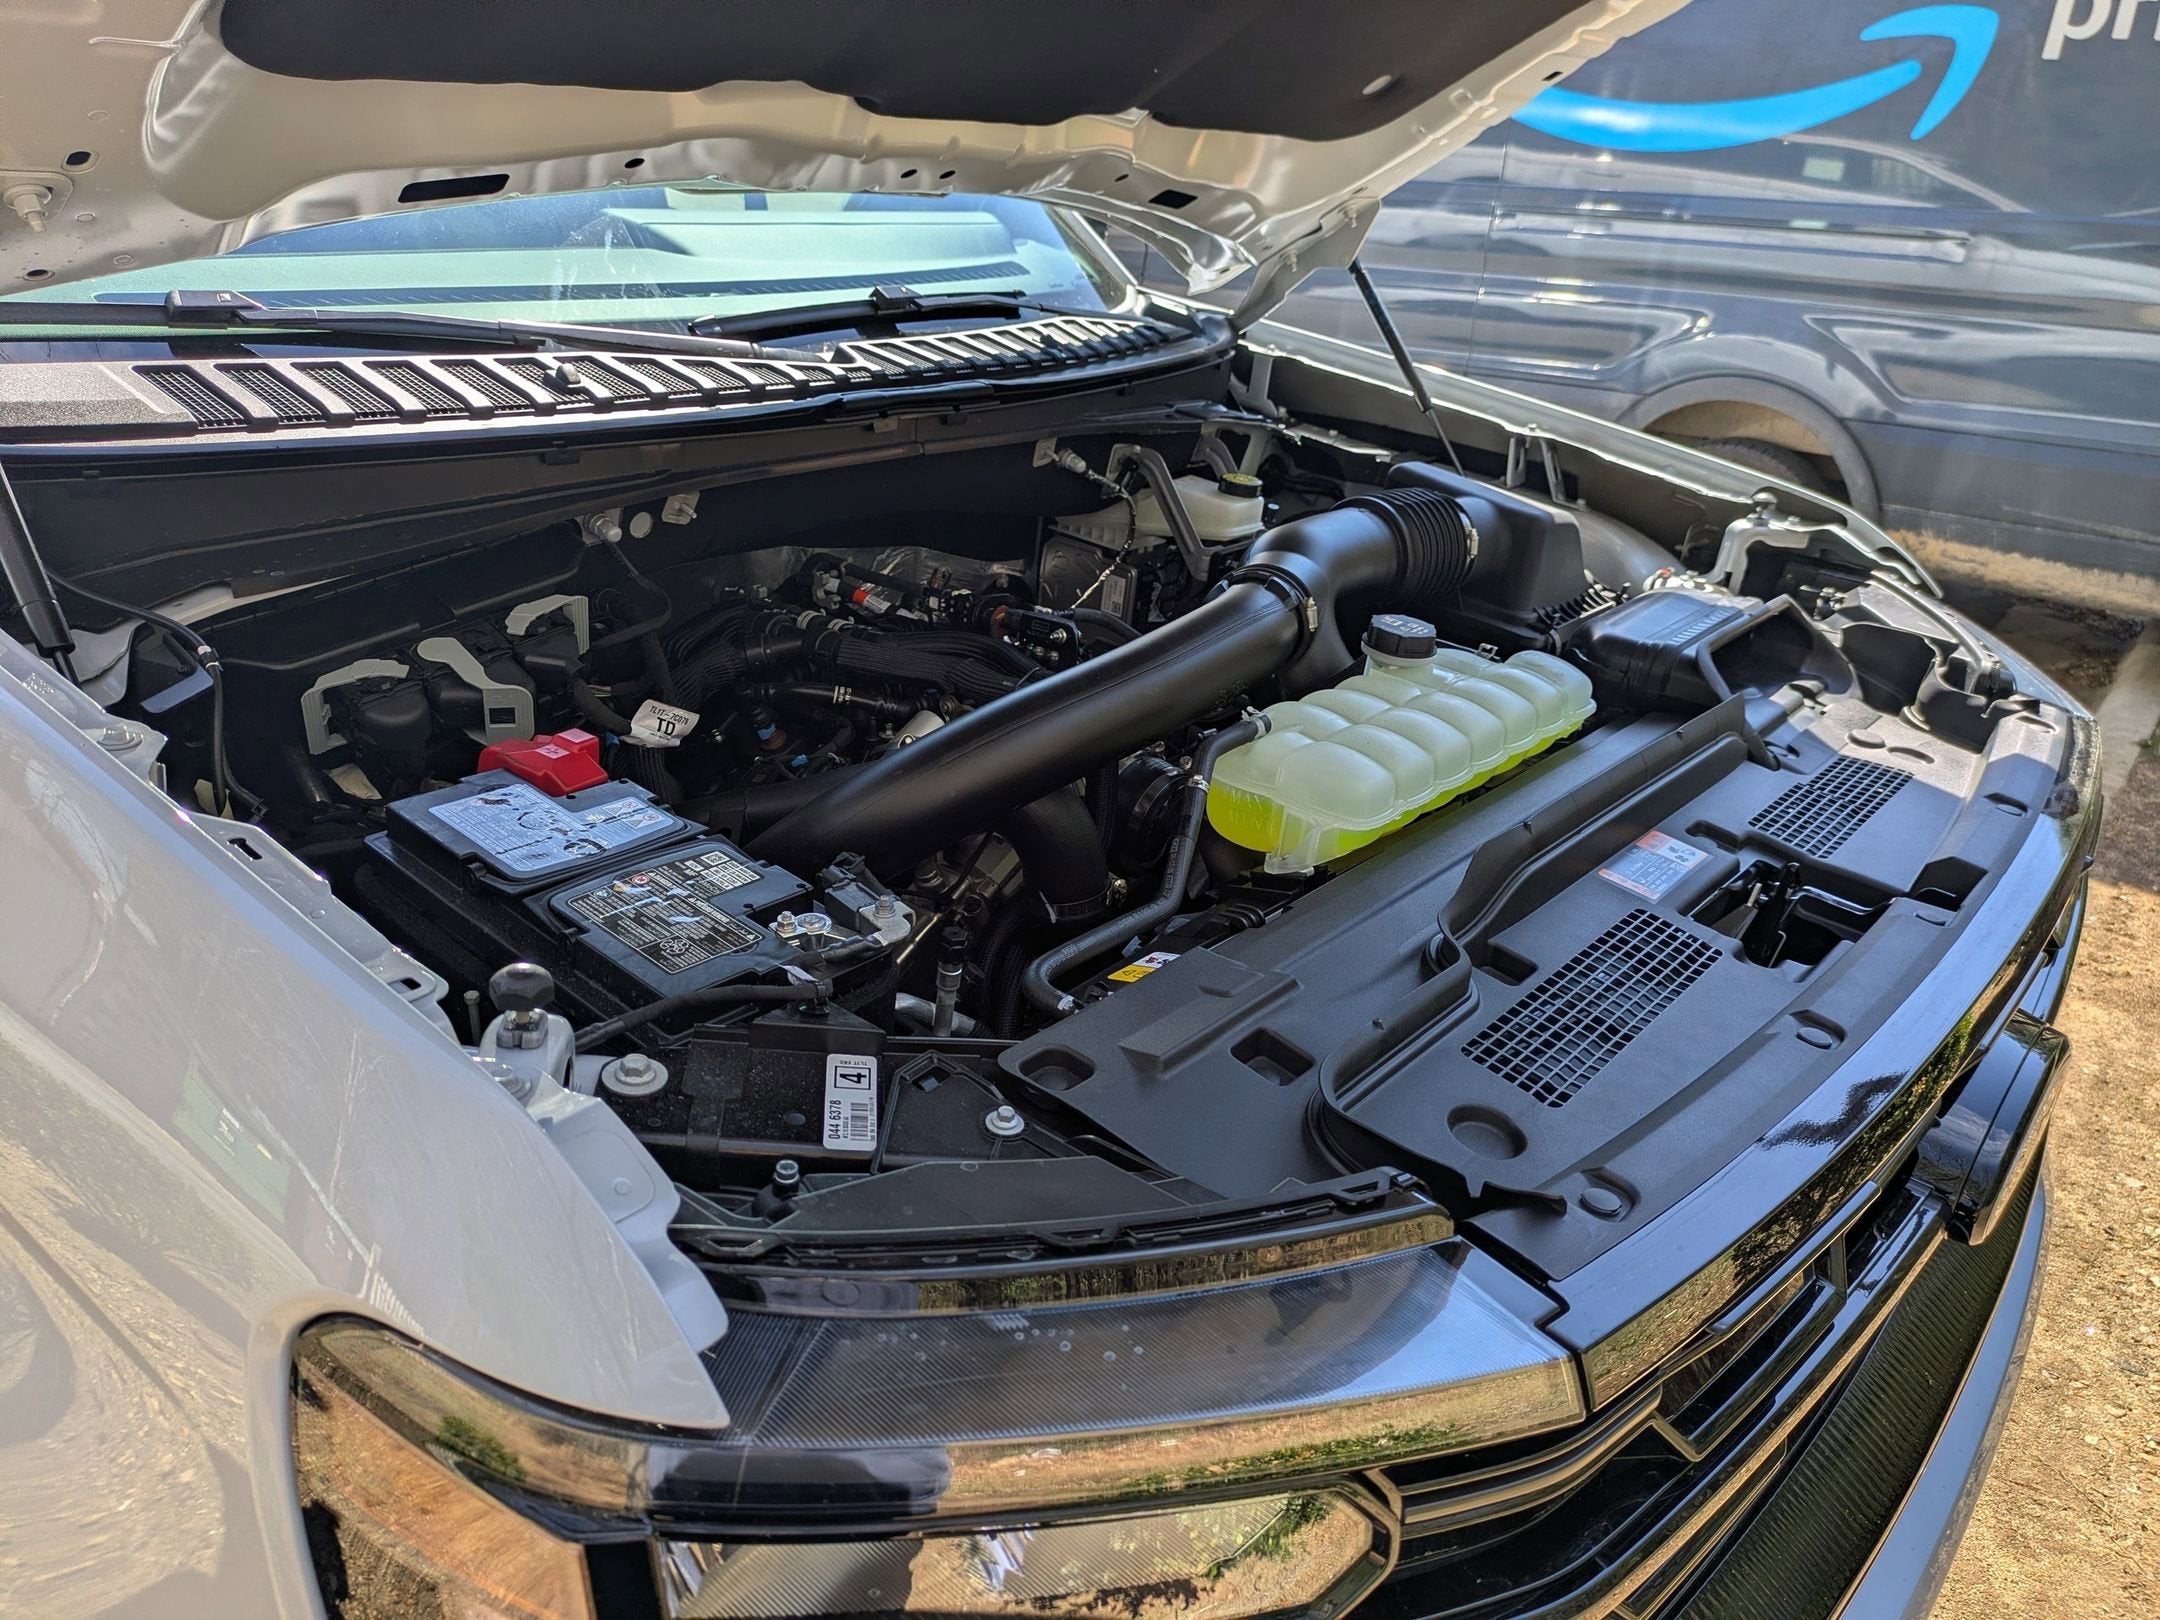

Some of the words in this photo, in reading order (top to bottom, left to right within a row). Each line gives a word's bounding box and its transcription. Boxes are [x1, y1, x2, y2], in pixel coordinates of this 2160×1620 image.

[2041, 0, 2160, 60] pr
[657, 716, 676, 736] TD
[839, 1072, 867, 1085] 4
[829, 1099, 842, 1121] 6378
[828, 1122, 841, 1140] 044
